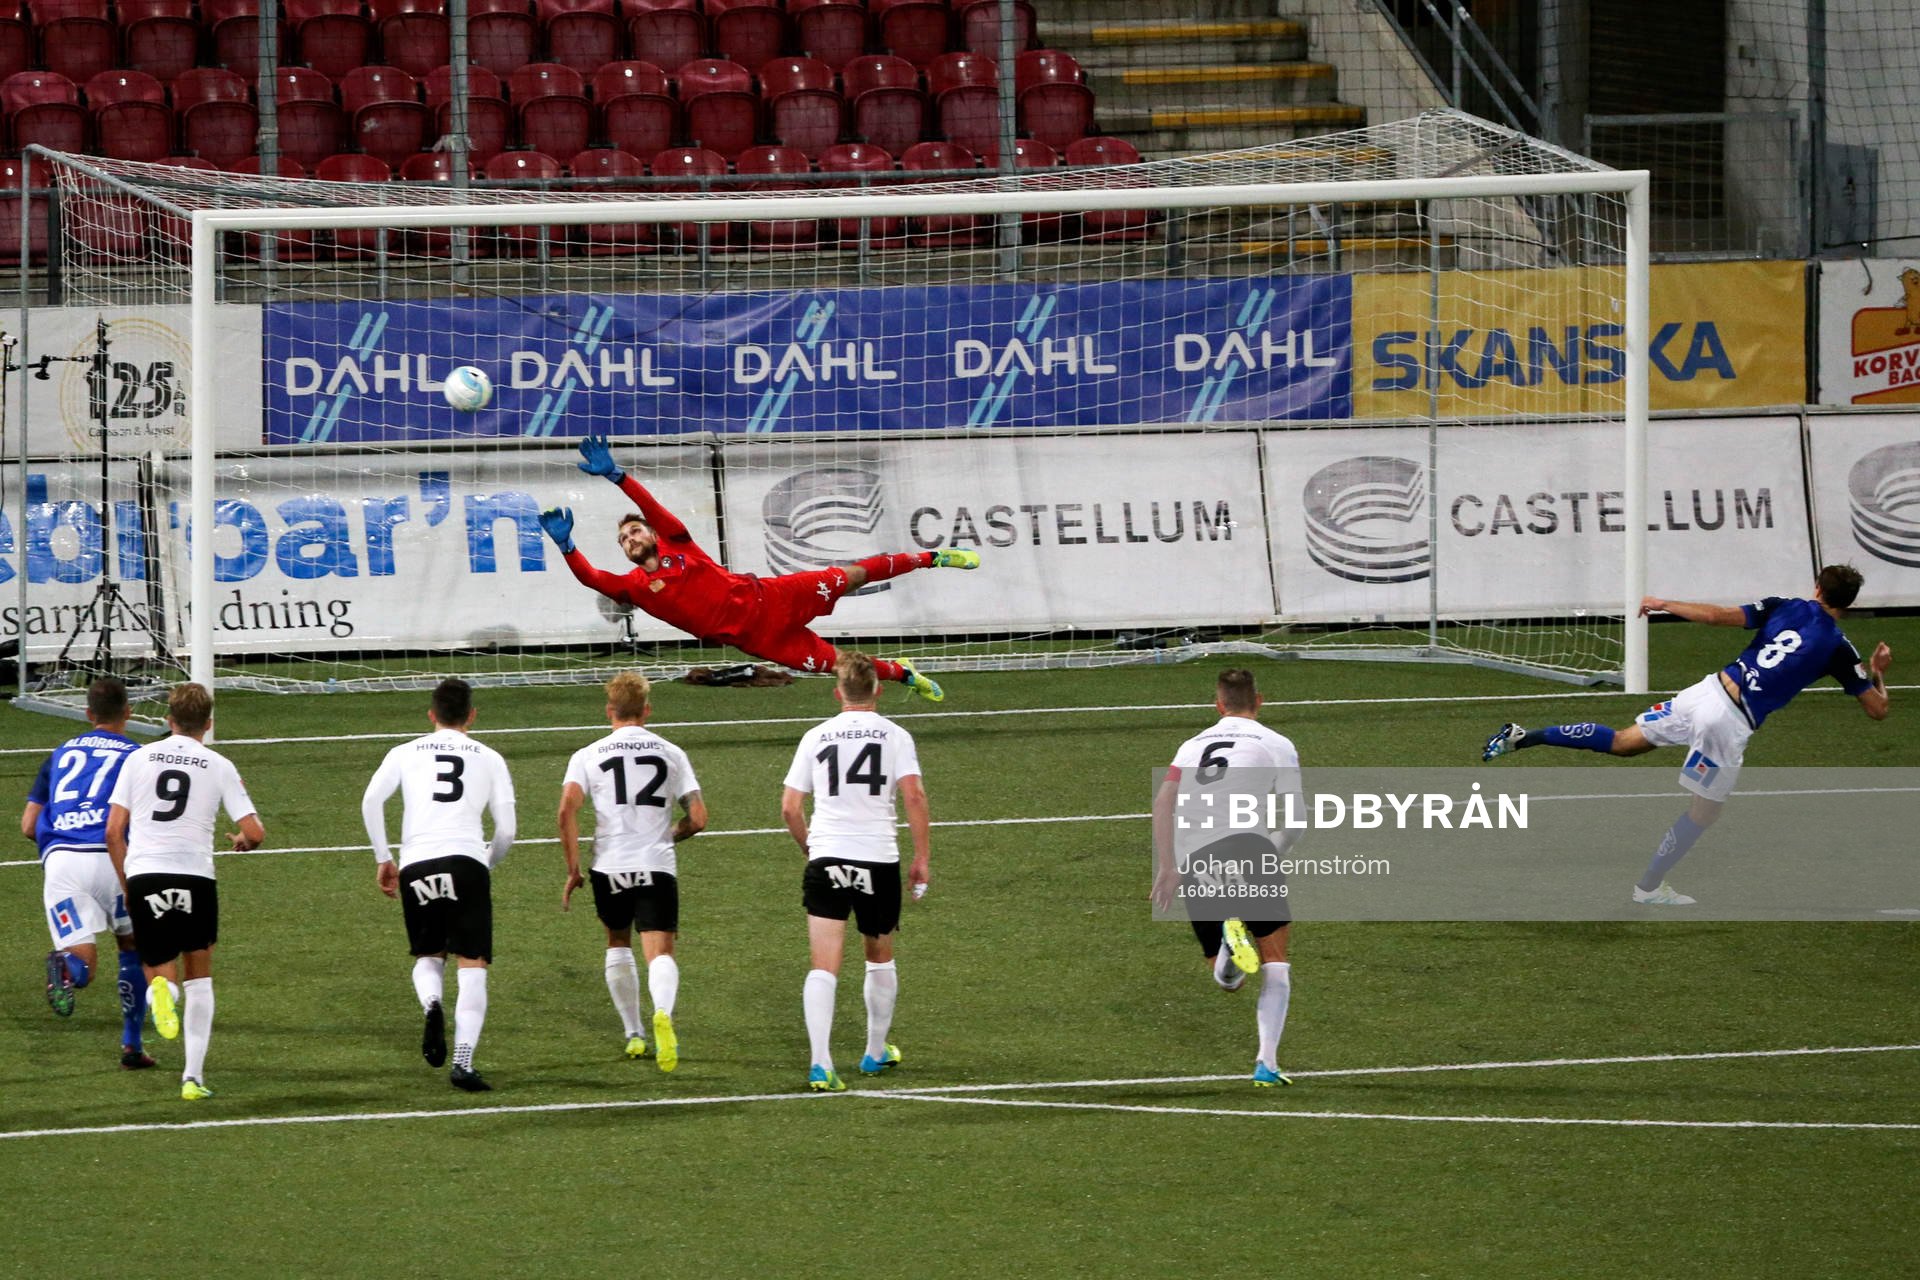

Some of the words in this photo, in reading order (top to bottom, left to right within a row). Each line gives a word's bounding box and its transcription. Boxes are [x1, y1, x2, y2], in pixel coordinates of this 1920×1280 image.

[511, 347, 676, 390] DAHL
[734, 341, 898, 385] DAHL
[954, 335, 1117, 378] DAHL
[1174, 329, 1337, 373] DAHL
[1372, 321, 1737, 392] SKANSKA
[285, 354, 446, 396] DAHL
[910, 498, 1233, 549] CASTELLUM
[1450, 488, 1774, 537] CASTELUM
[0, 600, 152, 635] sarnas
[184, 590, 354, 640] dning
[1757, 629, 1803, 669] 8
[54, 749, 123, 804] 27
[149, 752, 208, 769] BROBERG
[432, 754, 465, 803] 3
[598, 755, 668, 808] 12
[816, 742, 888, 797] 14
[1195, 741, 1236, 786] 6
[152, 769, 191, 822] 9
[53, 808, 106, 832] ABAX
[409, 872, 458, 906] NA
[825, 865, 875, 895] NA
[145, 887, 193, 920] NA
